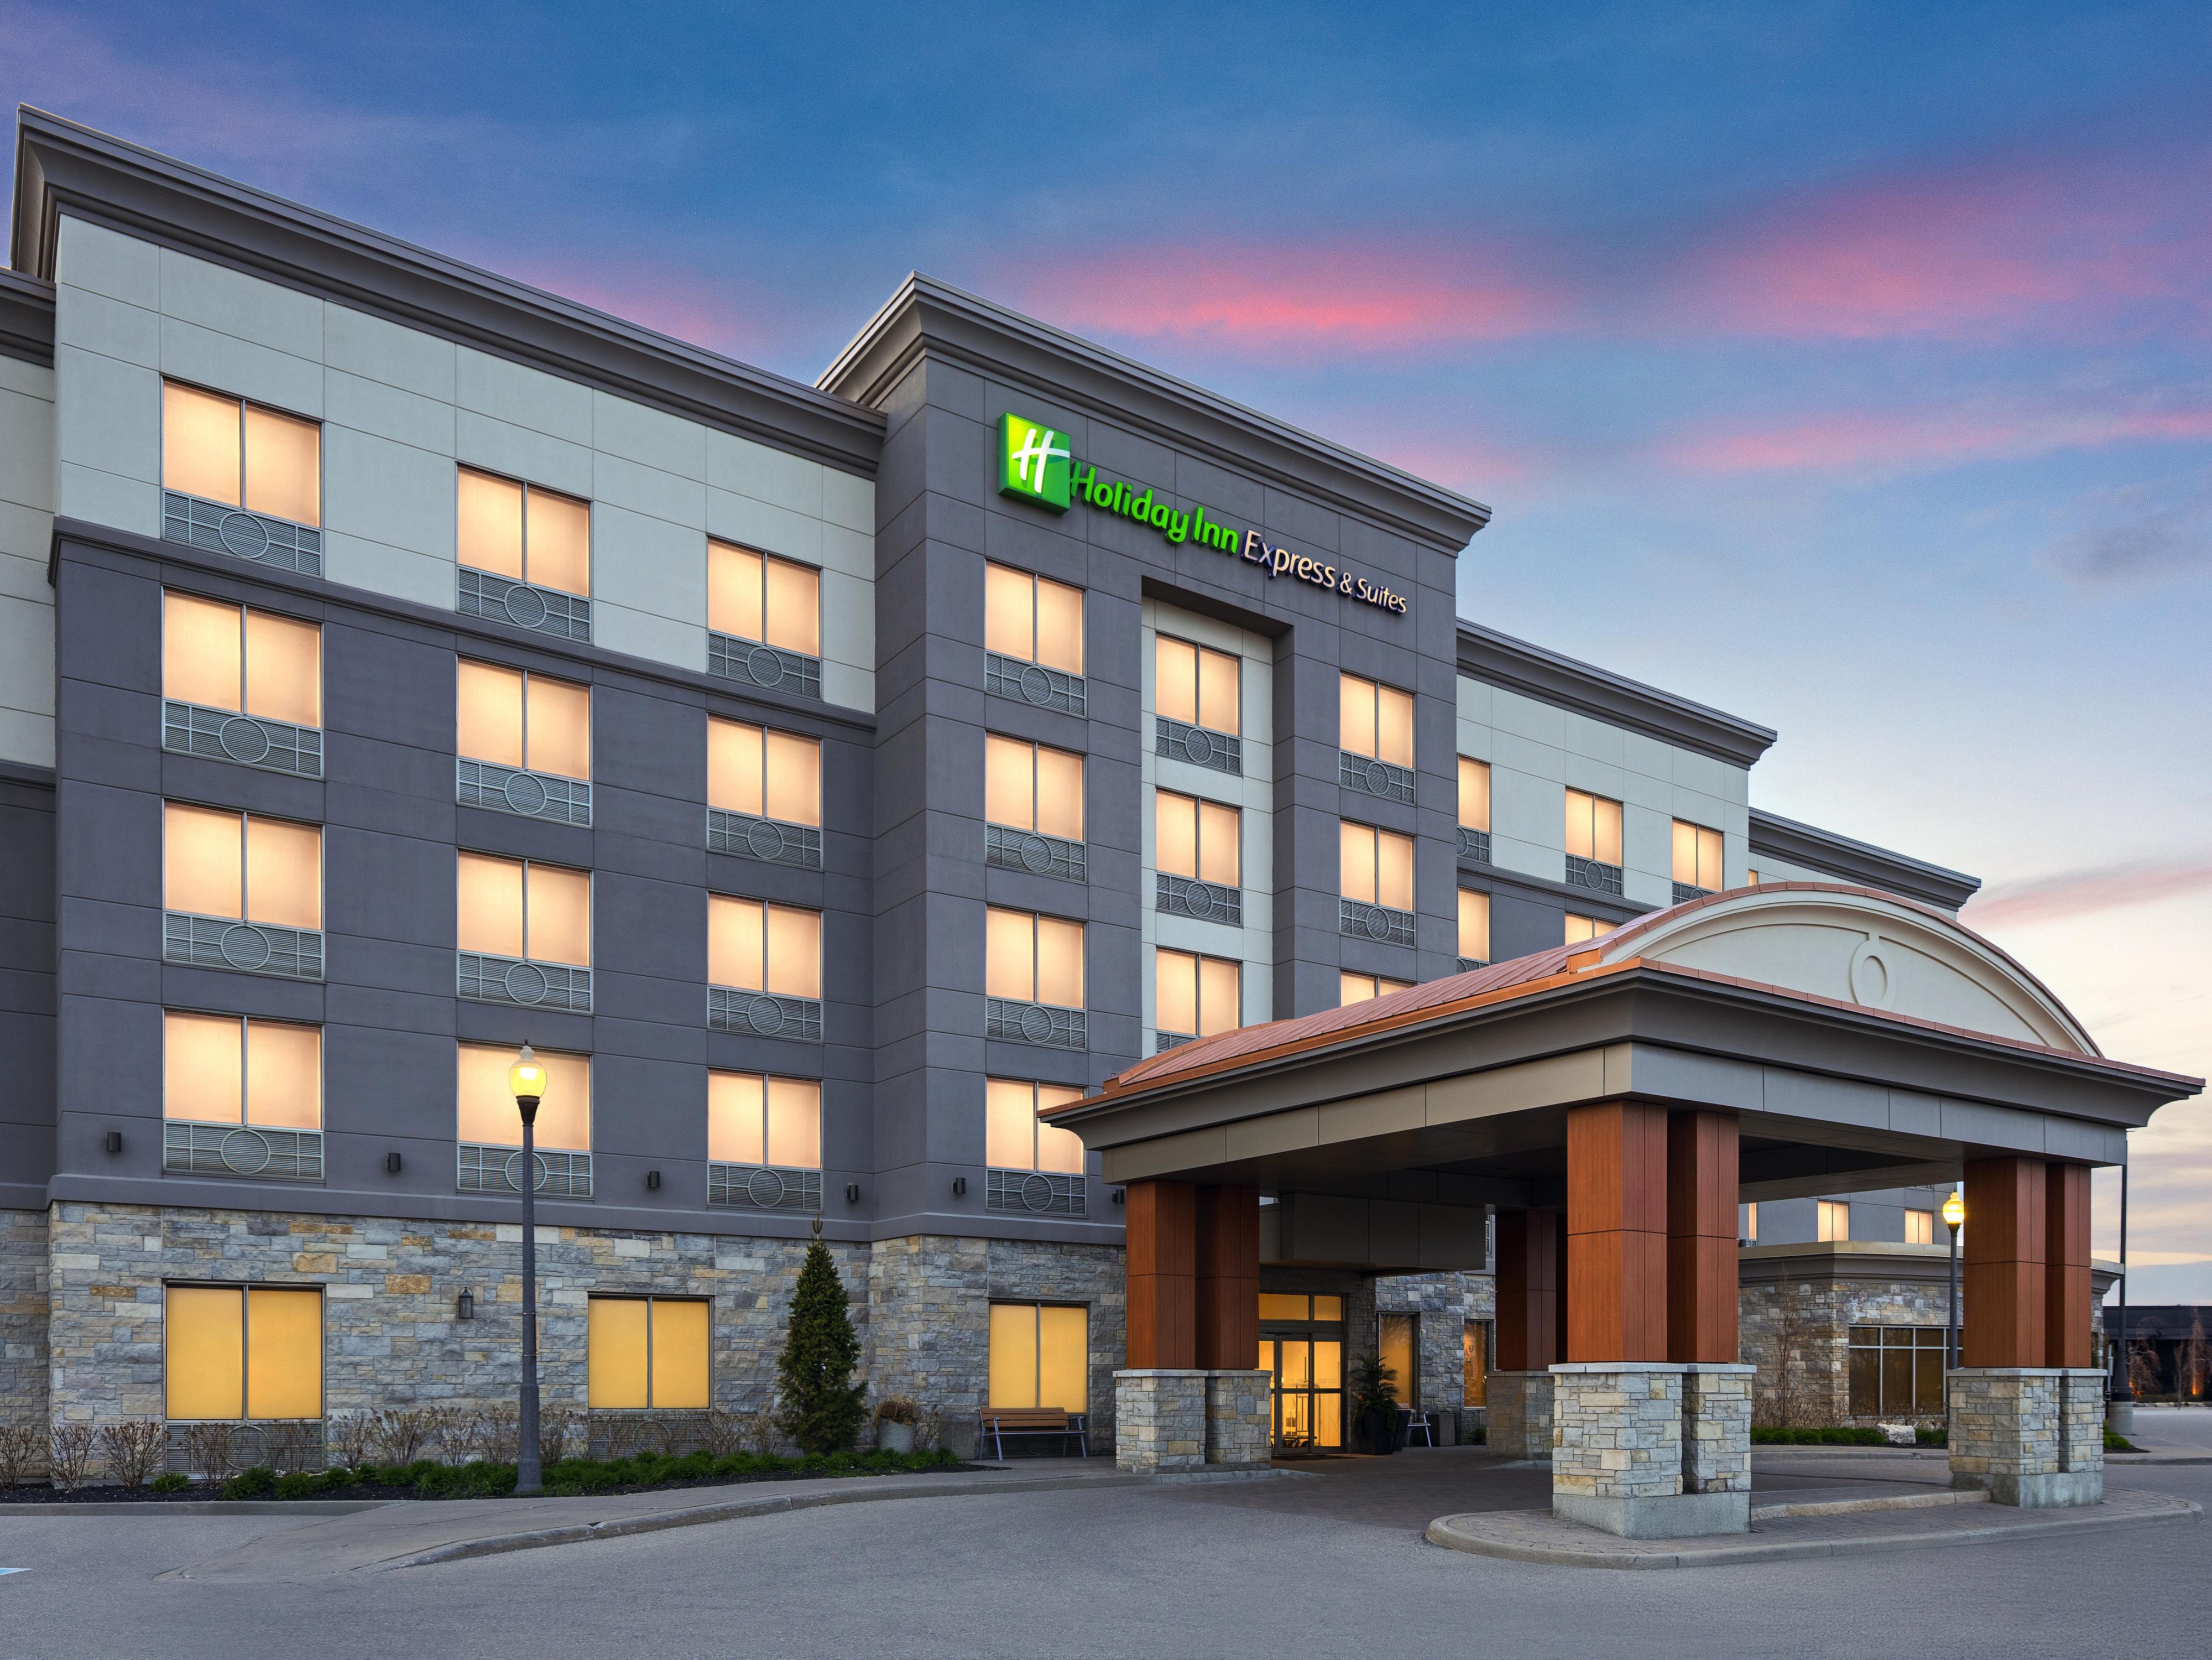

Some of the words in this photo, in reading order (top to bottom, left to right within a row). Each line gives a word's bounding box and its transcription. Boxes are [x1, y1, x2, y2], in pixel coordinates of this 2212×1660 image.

[1070, 460, 1190, 544] Holiday
[1192, 506, 1239, 554] Inn
[1243, 529, 1336, 589] Express
[1338, 572, 1353, 595] &
[1356, 577, 1407, 614] Suites
